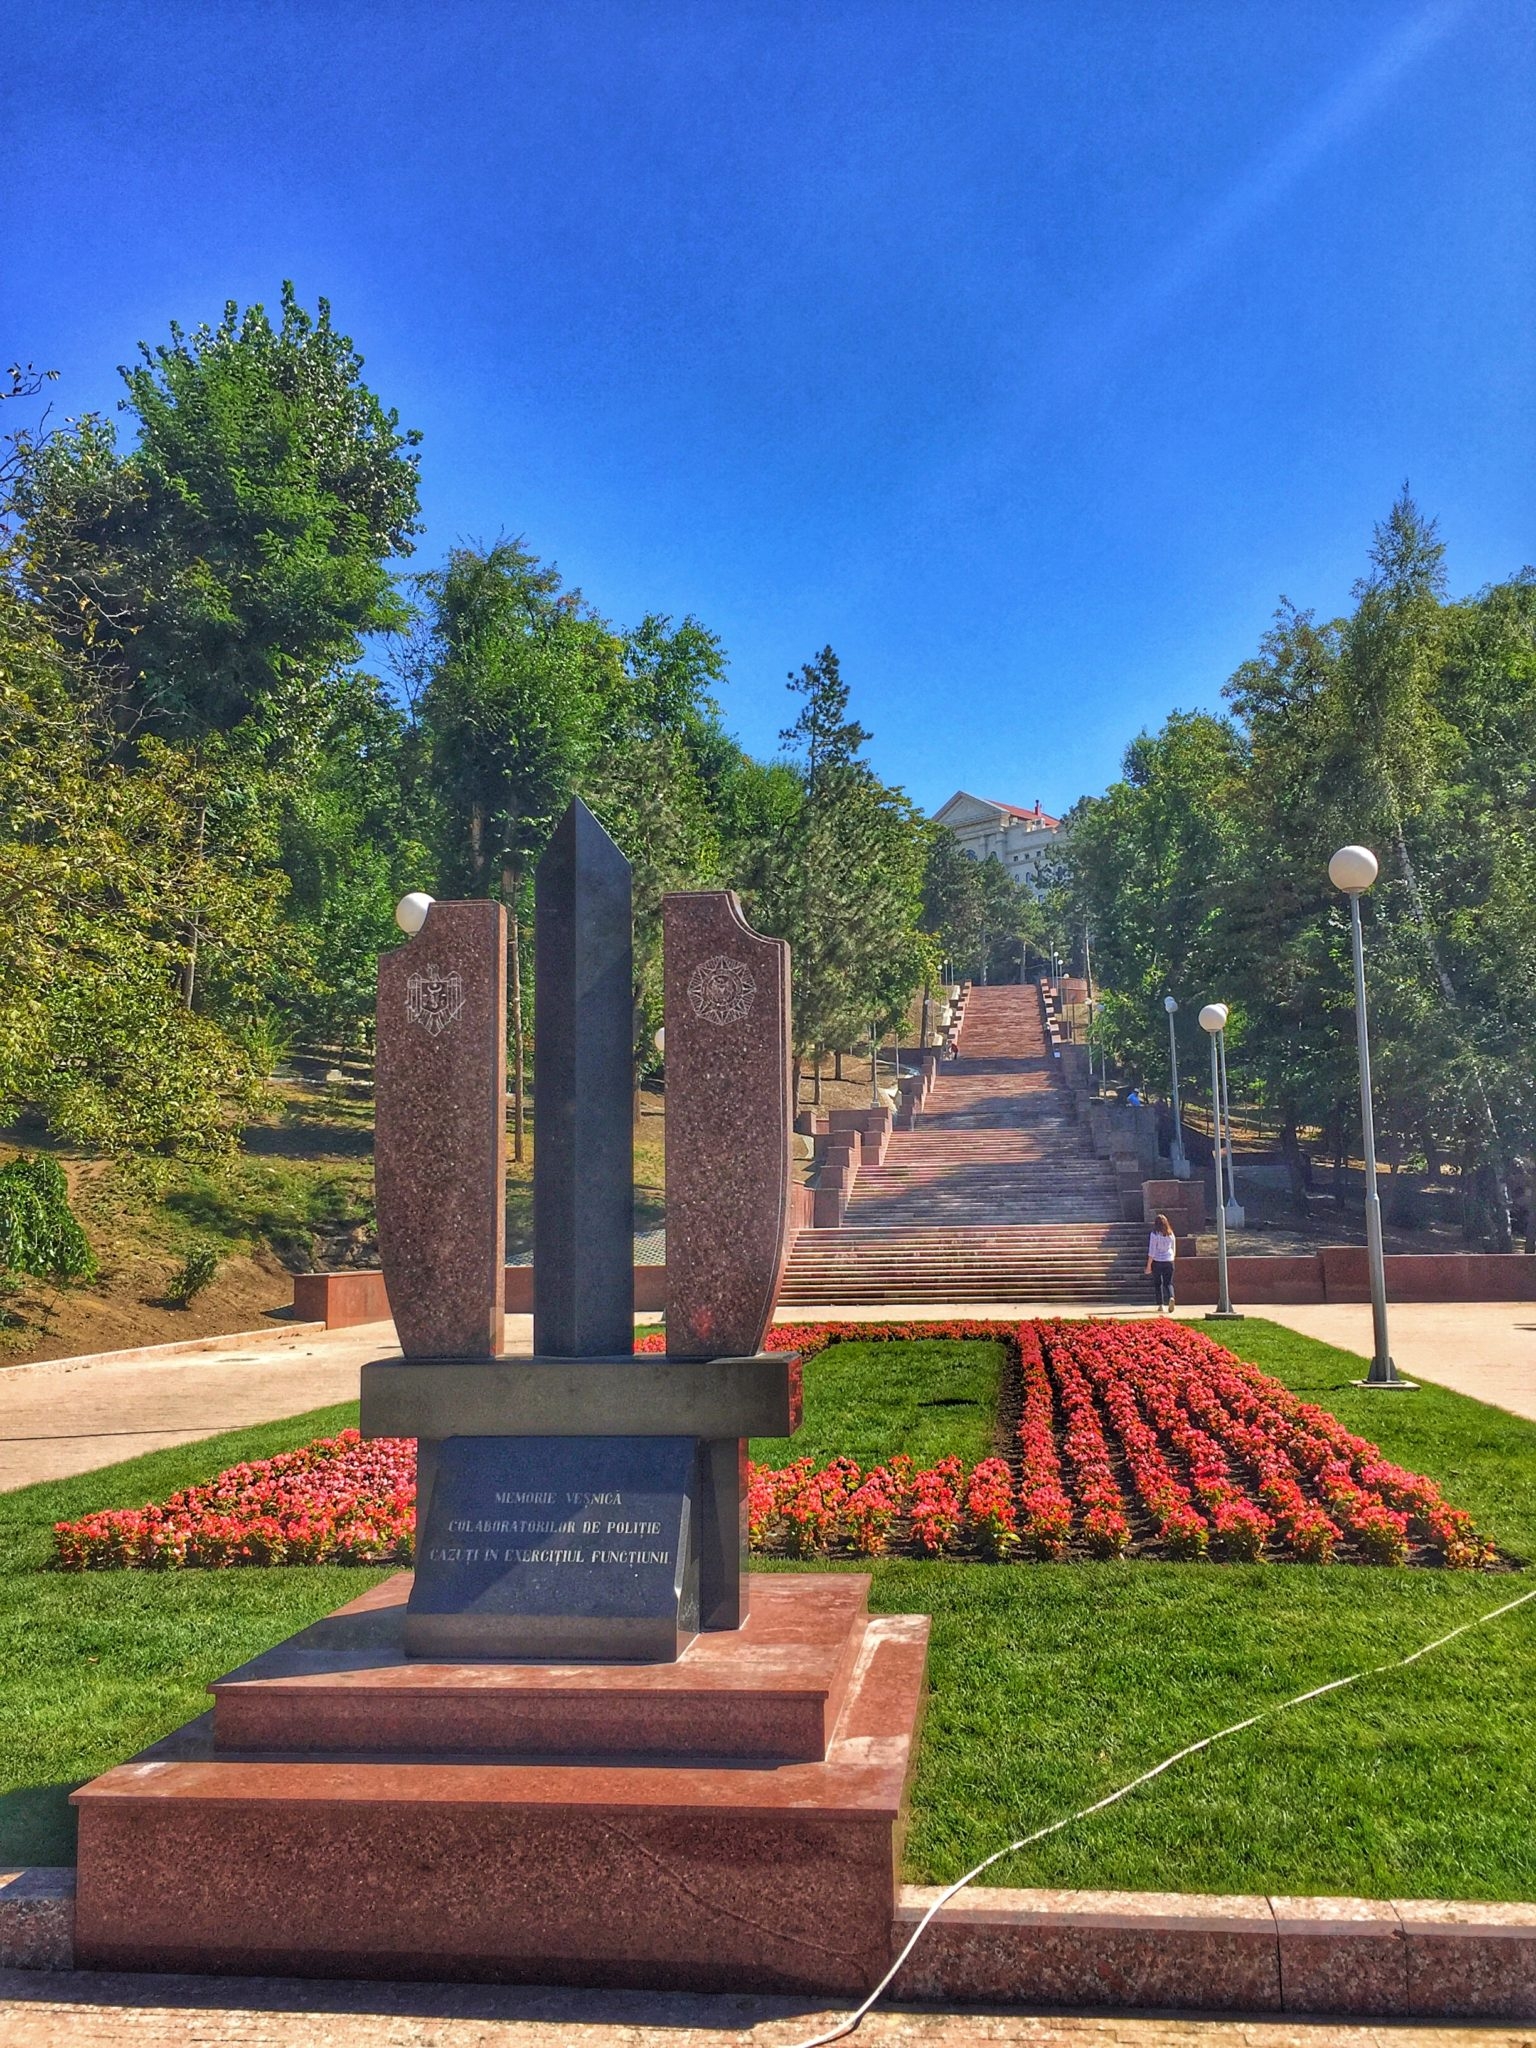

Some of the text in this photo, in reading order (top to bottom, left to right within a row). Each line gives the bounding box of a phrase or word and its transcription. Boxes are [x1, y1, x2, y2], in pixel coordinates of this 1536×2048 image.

[495, 1492, 556, 1504] MEMORIE
[448, 1520, 661, 1538] COLABORATORILOR DE POLIȚIE
